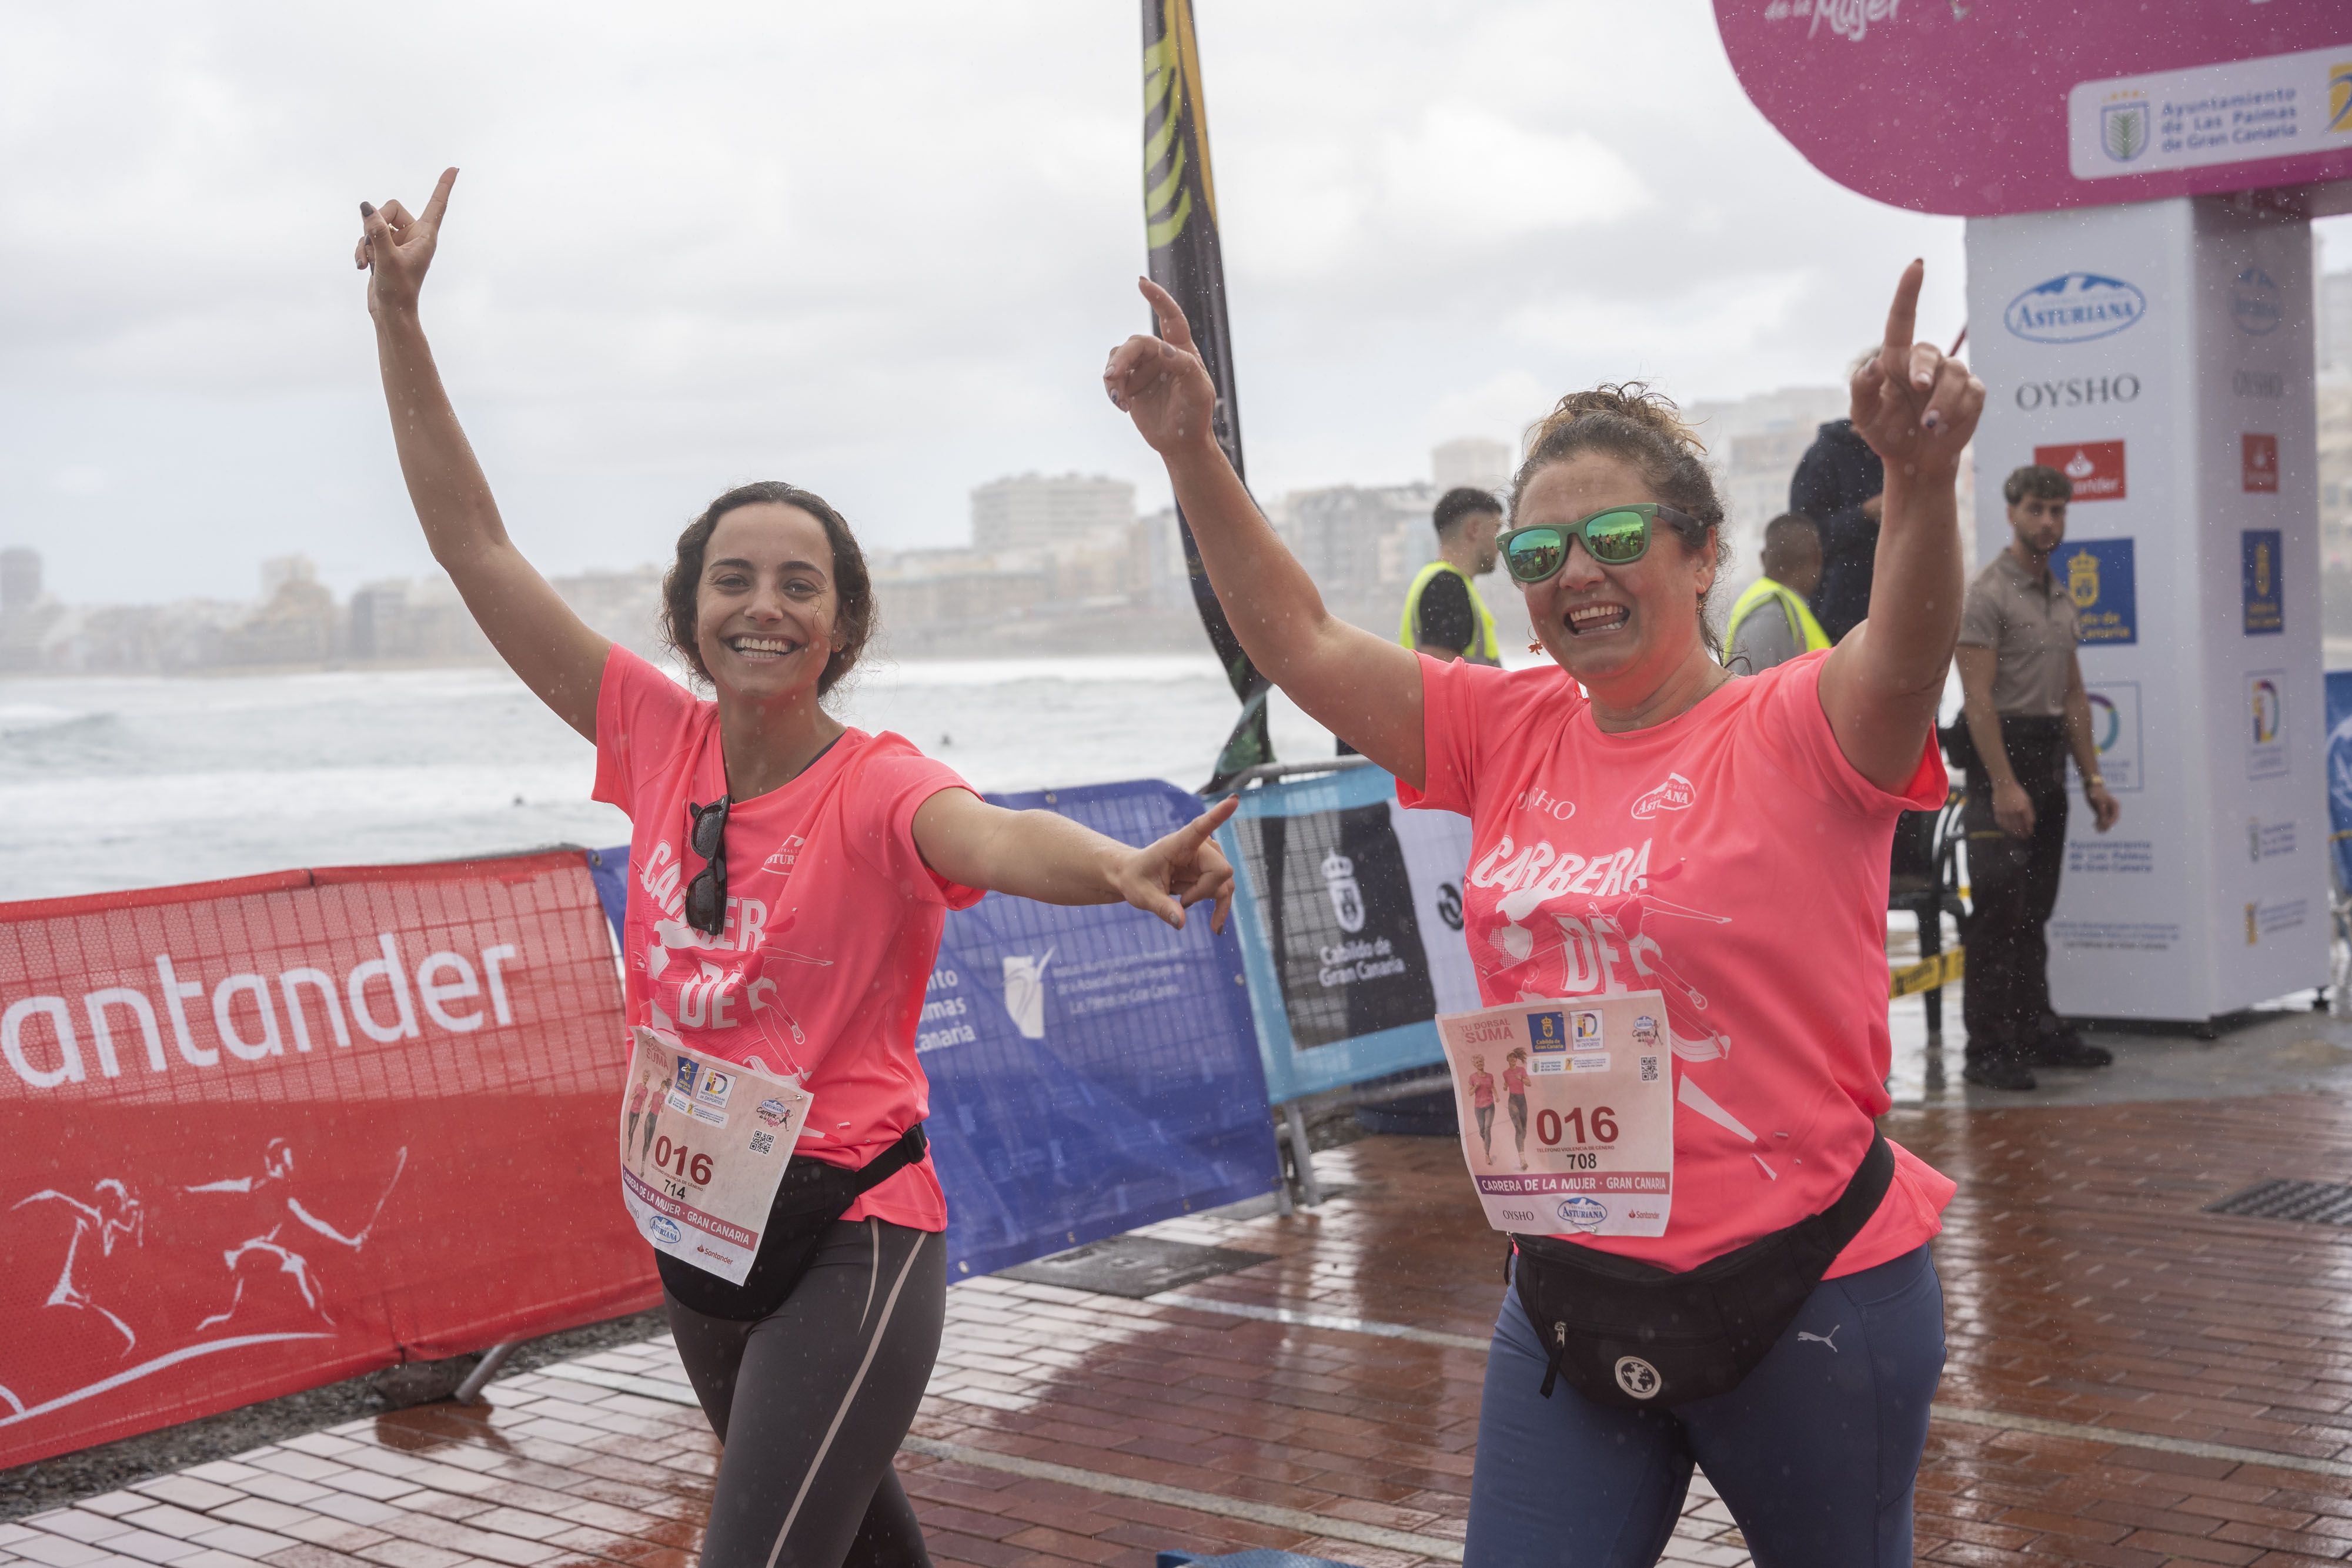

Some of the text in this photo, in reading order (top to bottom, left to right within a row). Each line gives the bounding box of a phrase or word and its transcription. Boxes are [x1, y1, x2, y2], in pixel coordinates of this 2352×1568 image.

[2162, 87, 2296, 116] Ayuntamiento
[2162, 107, 2296, 135] de Las Palmas
[2162, 125, 2296, 153] de Gran Canaria
[2016, 301, 2134, 333] ASTURIANA
[2015, 373, 2140, 412] OYSHO
[1471, 835, 1652, 896] CARRERA
[1320, 936, 1392, 965] Cabildo de
[1551, 913, 1628, 996] DE
[1318, 955, 1406, 988] Gran Canaria
[676, 958, 738, 1029] DE
[1465, 1027, 1514, 1044] SUMA
[1475, 1018, 1511, 1030] DORSAL
[647, 1048, 669, 1070] SUMA
[704, 1096, 723, 1105] DEPORTES
[756, 1106, 777, 1119] Carrera
[763, 1102, 783, 1112] ASTURIANA
[1536, 1106, 1618, 1145] 016
[655, 1135, 713, 1185] 016
[1566, 1153, 1596, 1169] 708
[664, 1179, 686, 1200] 714
[1482, 1176, 1666, 1191] CARRERA DE LA MUJER GRAN CANARIA
[624, 1169, 639, 1193] CARRERA
[639, 1186, 646, 1198] DE
[647, 1191, 654, 1204] LA
[655, 1196, 681, 1216] MUJER
[687, 1211, 709, 1229] GRAN
[710, 1221, 750, 1245] CANARIA
[1502, 1209, 1535, 1221] OYSHO
[1563, 1206, 1603, 1218] ASTURIANA
[1636, 1211, 1660, 1219] Santander
[704, 1248, 733, 1265] Santander
